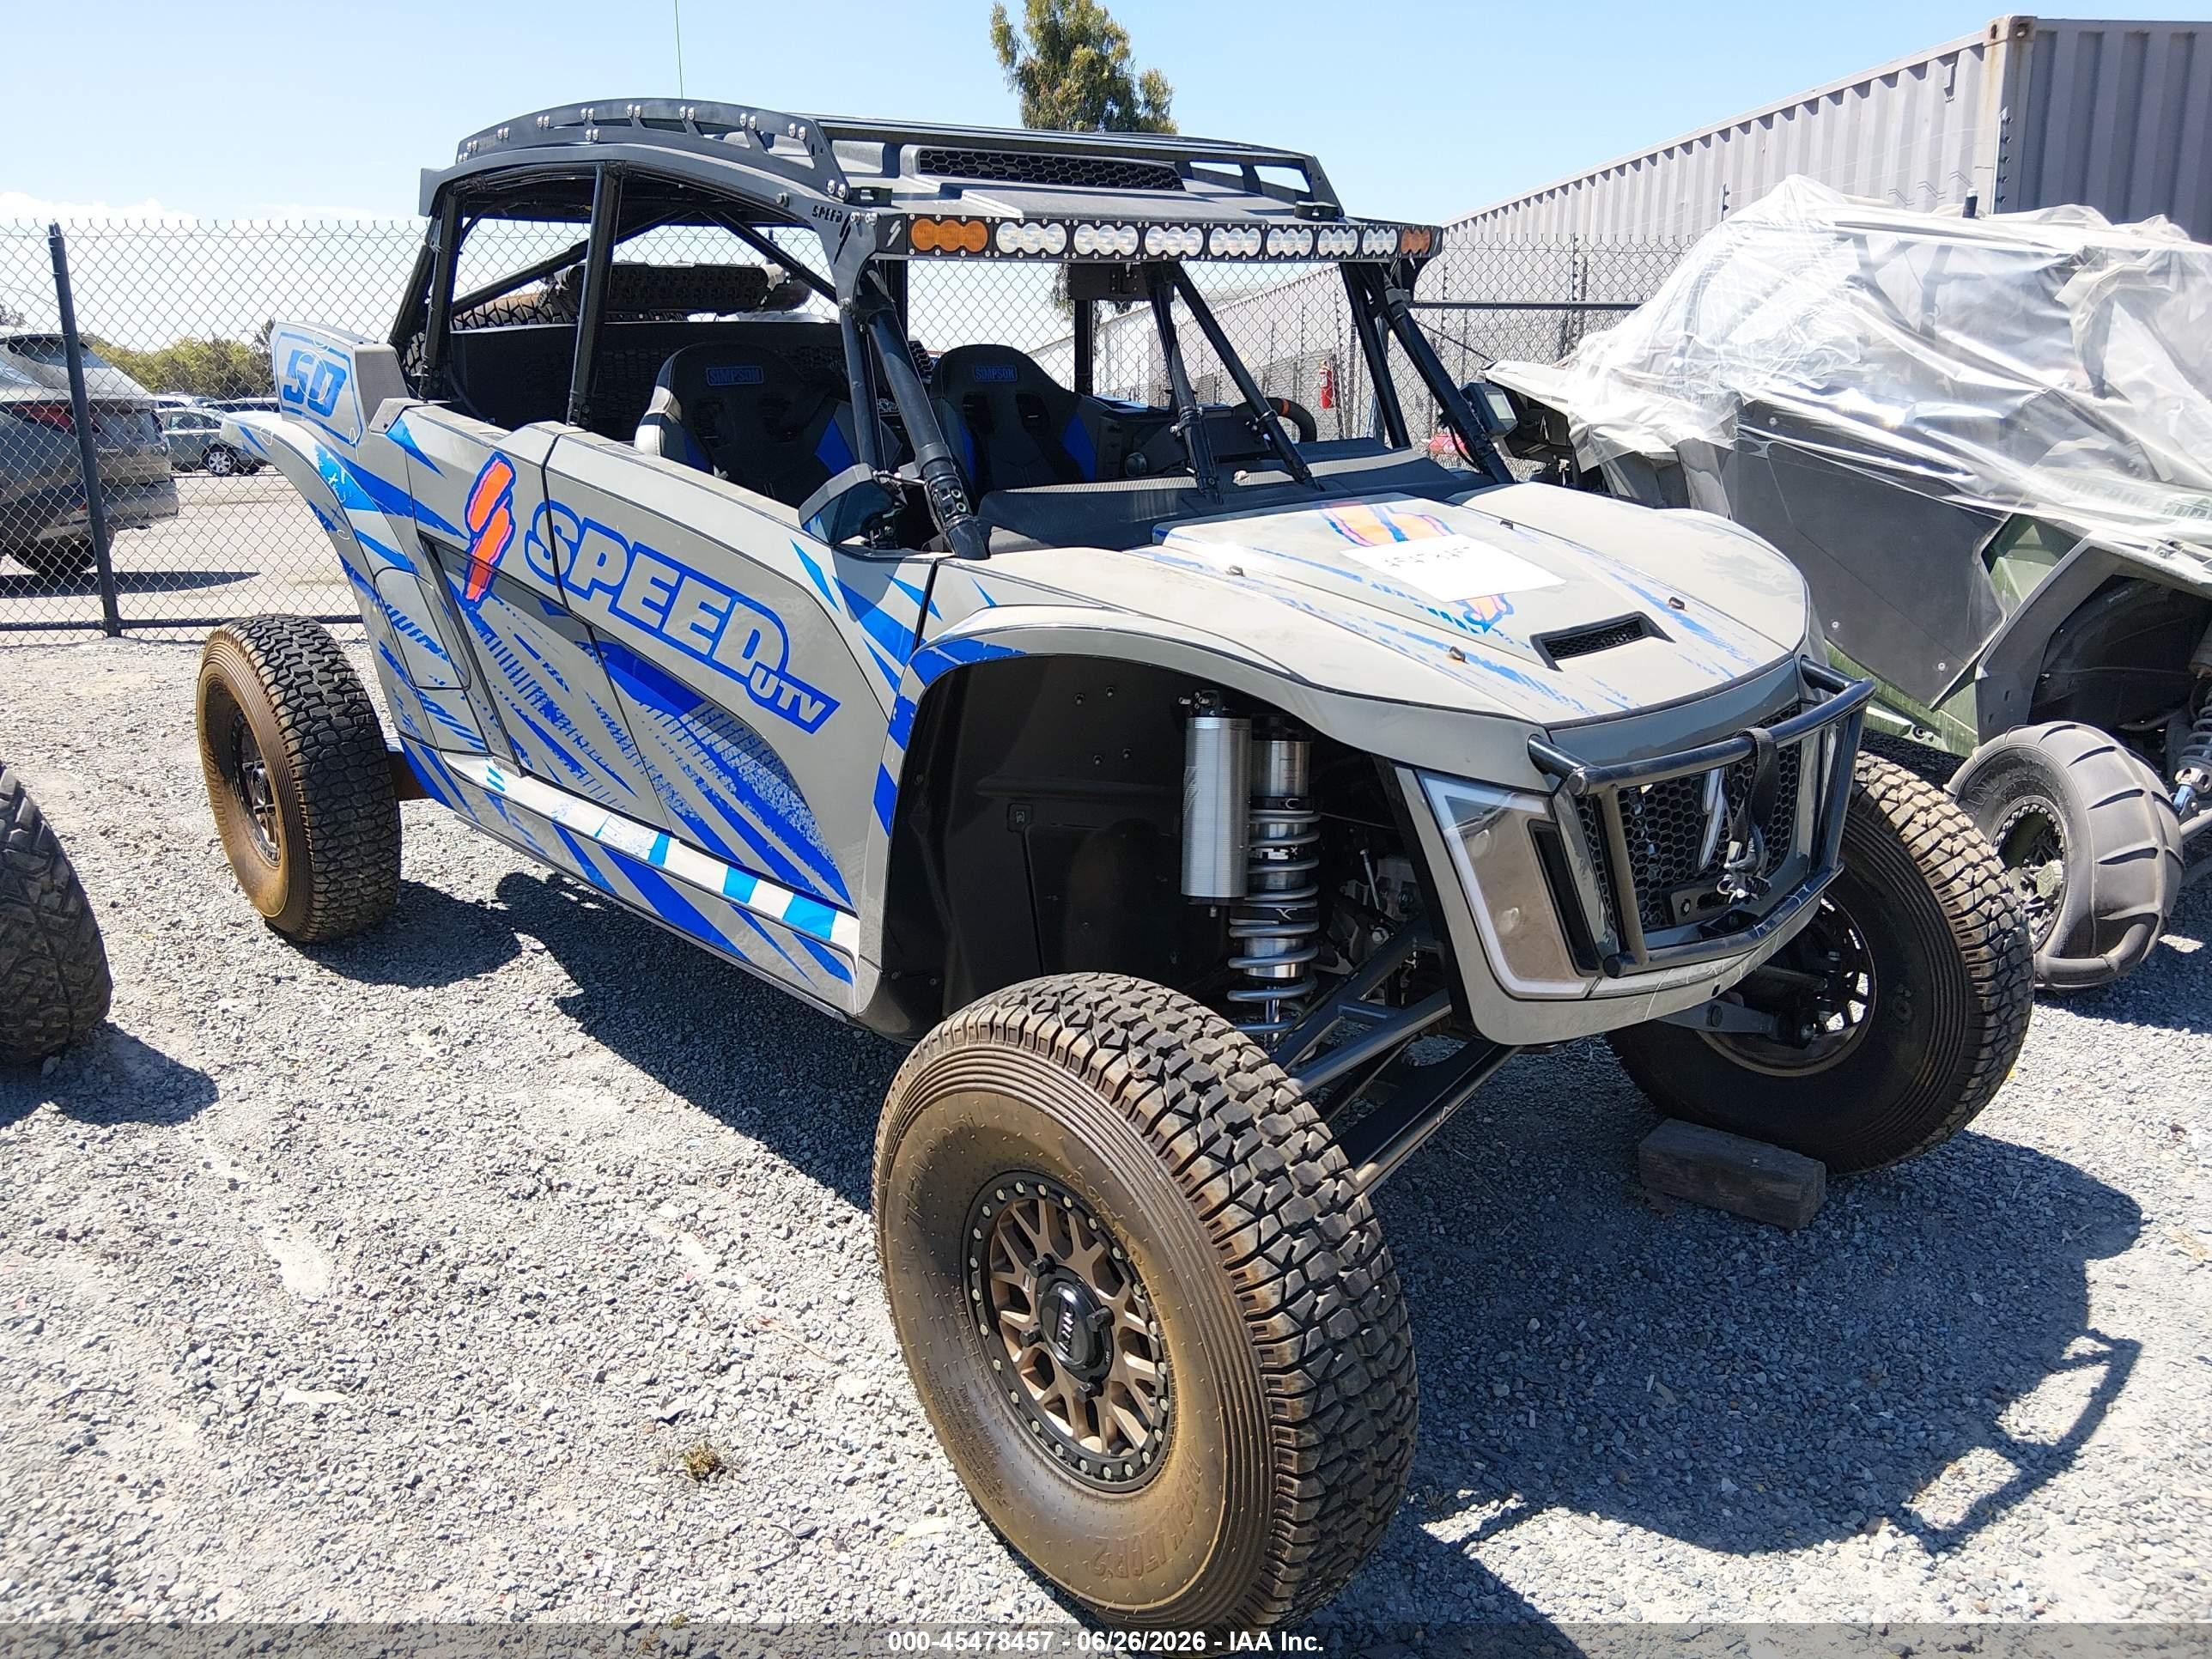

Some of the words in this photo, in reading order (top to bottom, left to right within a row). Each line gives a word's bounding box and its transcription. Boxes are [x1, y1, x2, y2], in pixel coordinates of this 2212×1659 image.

[811, 205, 842, 223] SPEED
[283, 349, 347, 417] 50
[709, 369, 761, 383] SIMPSON
[975, 368, 1015, 380] SIMPSON
[526, 501, 787, 679] SPEED
[749, 663, 830, 726] UTV
